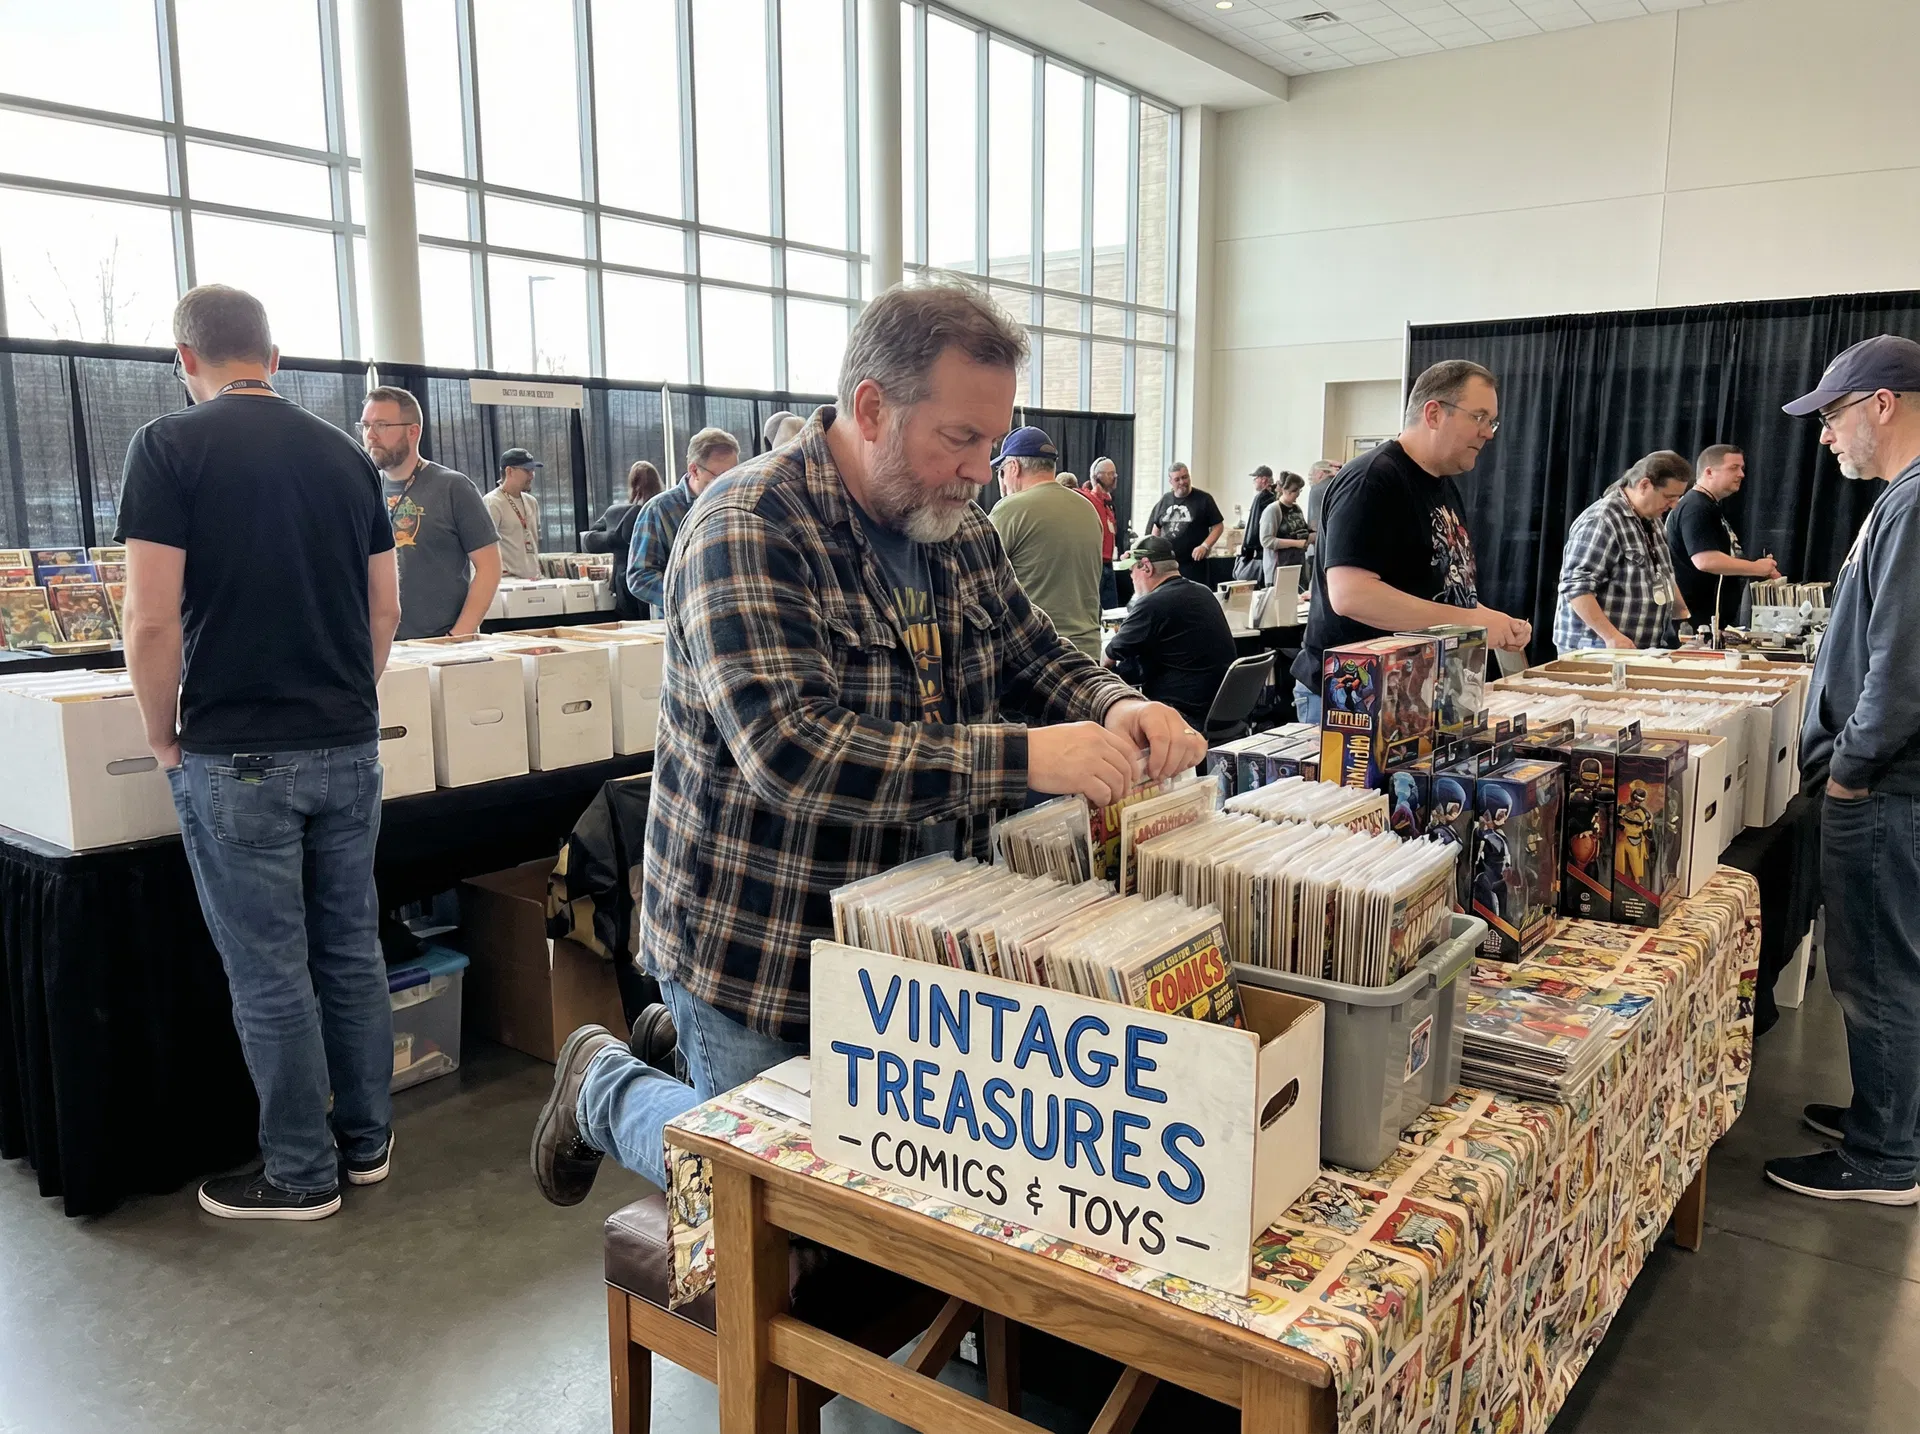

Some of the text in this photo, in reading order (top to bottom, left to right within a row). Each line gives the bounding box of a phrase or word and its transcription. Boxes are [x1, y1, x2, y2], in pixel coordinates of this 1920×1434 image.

[858, 967, 1169, 1104] VINTAGE
[1150, 946, 1224, 1013] COMICS
[831, 1040, 1206, 1204] TREASURES
[871, 1131, 1166, 1255] COMICS & TOYS
